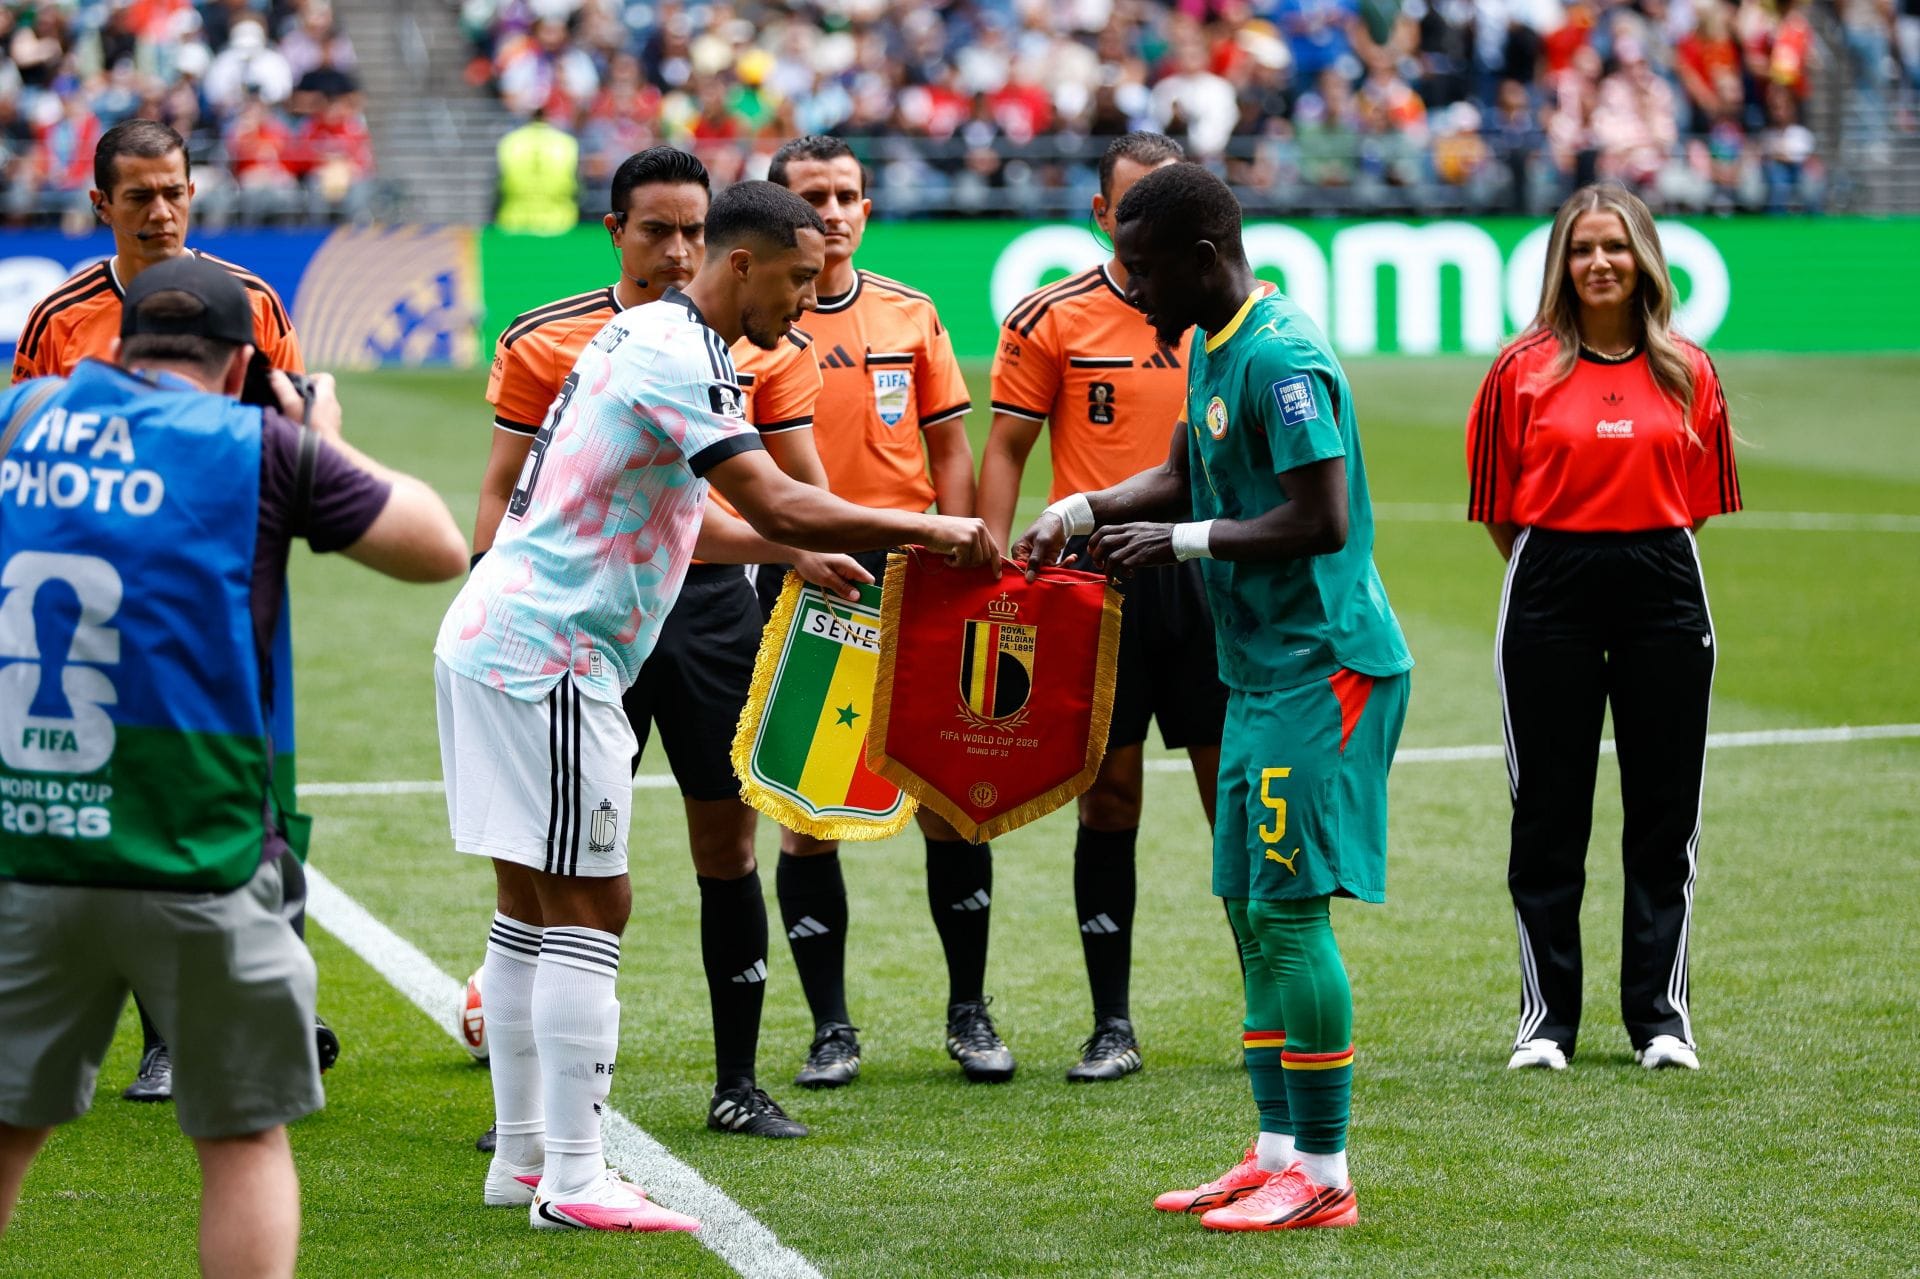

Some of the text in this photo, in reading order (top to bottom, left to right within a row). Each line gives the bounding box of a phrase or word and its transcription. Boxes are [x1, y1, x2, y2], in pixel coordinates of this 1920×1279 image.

[878, 374, 907, 387] FIFA
[1280, 382, 1305, 394] FOOTBALL
[1282, 389, 1308, 404] UNITES
[0, 459, 165, 517] PHOTO
[812, 614, 881, 650] SENE
[1000, 634, 1034, 643] BELGIAN
[1001, 626, 1026, 635] ROYAL
[22, 727, 79, 752] FIFA
[940, 731, 1039, 747] FIFA WORLD CUP 2026
[967, 746, 989, 755] ROUND
[67, 781, 113, 802] CUP
[1259, 767, 1293, 843] 5
[2, 799, 111, 838] 2026
